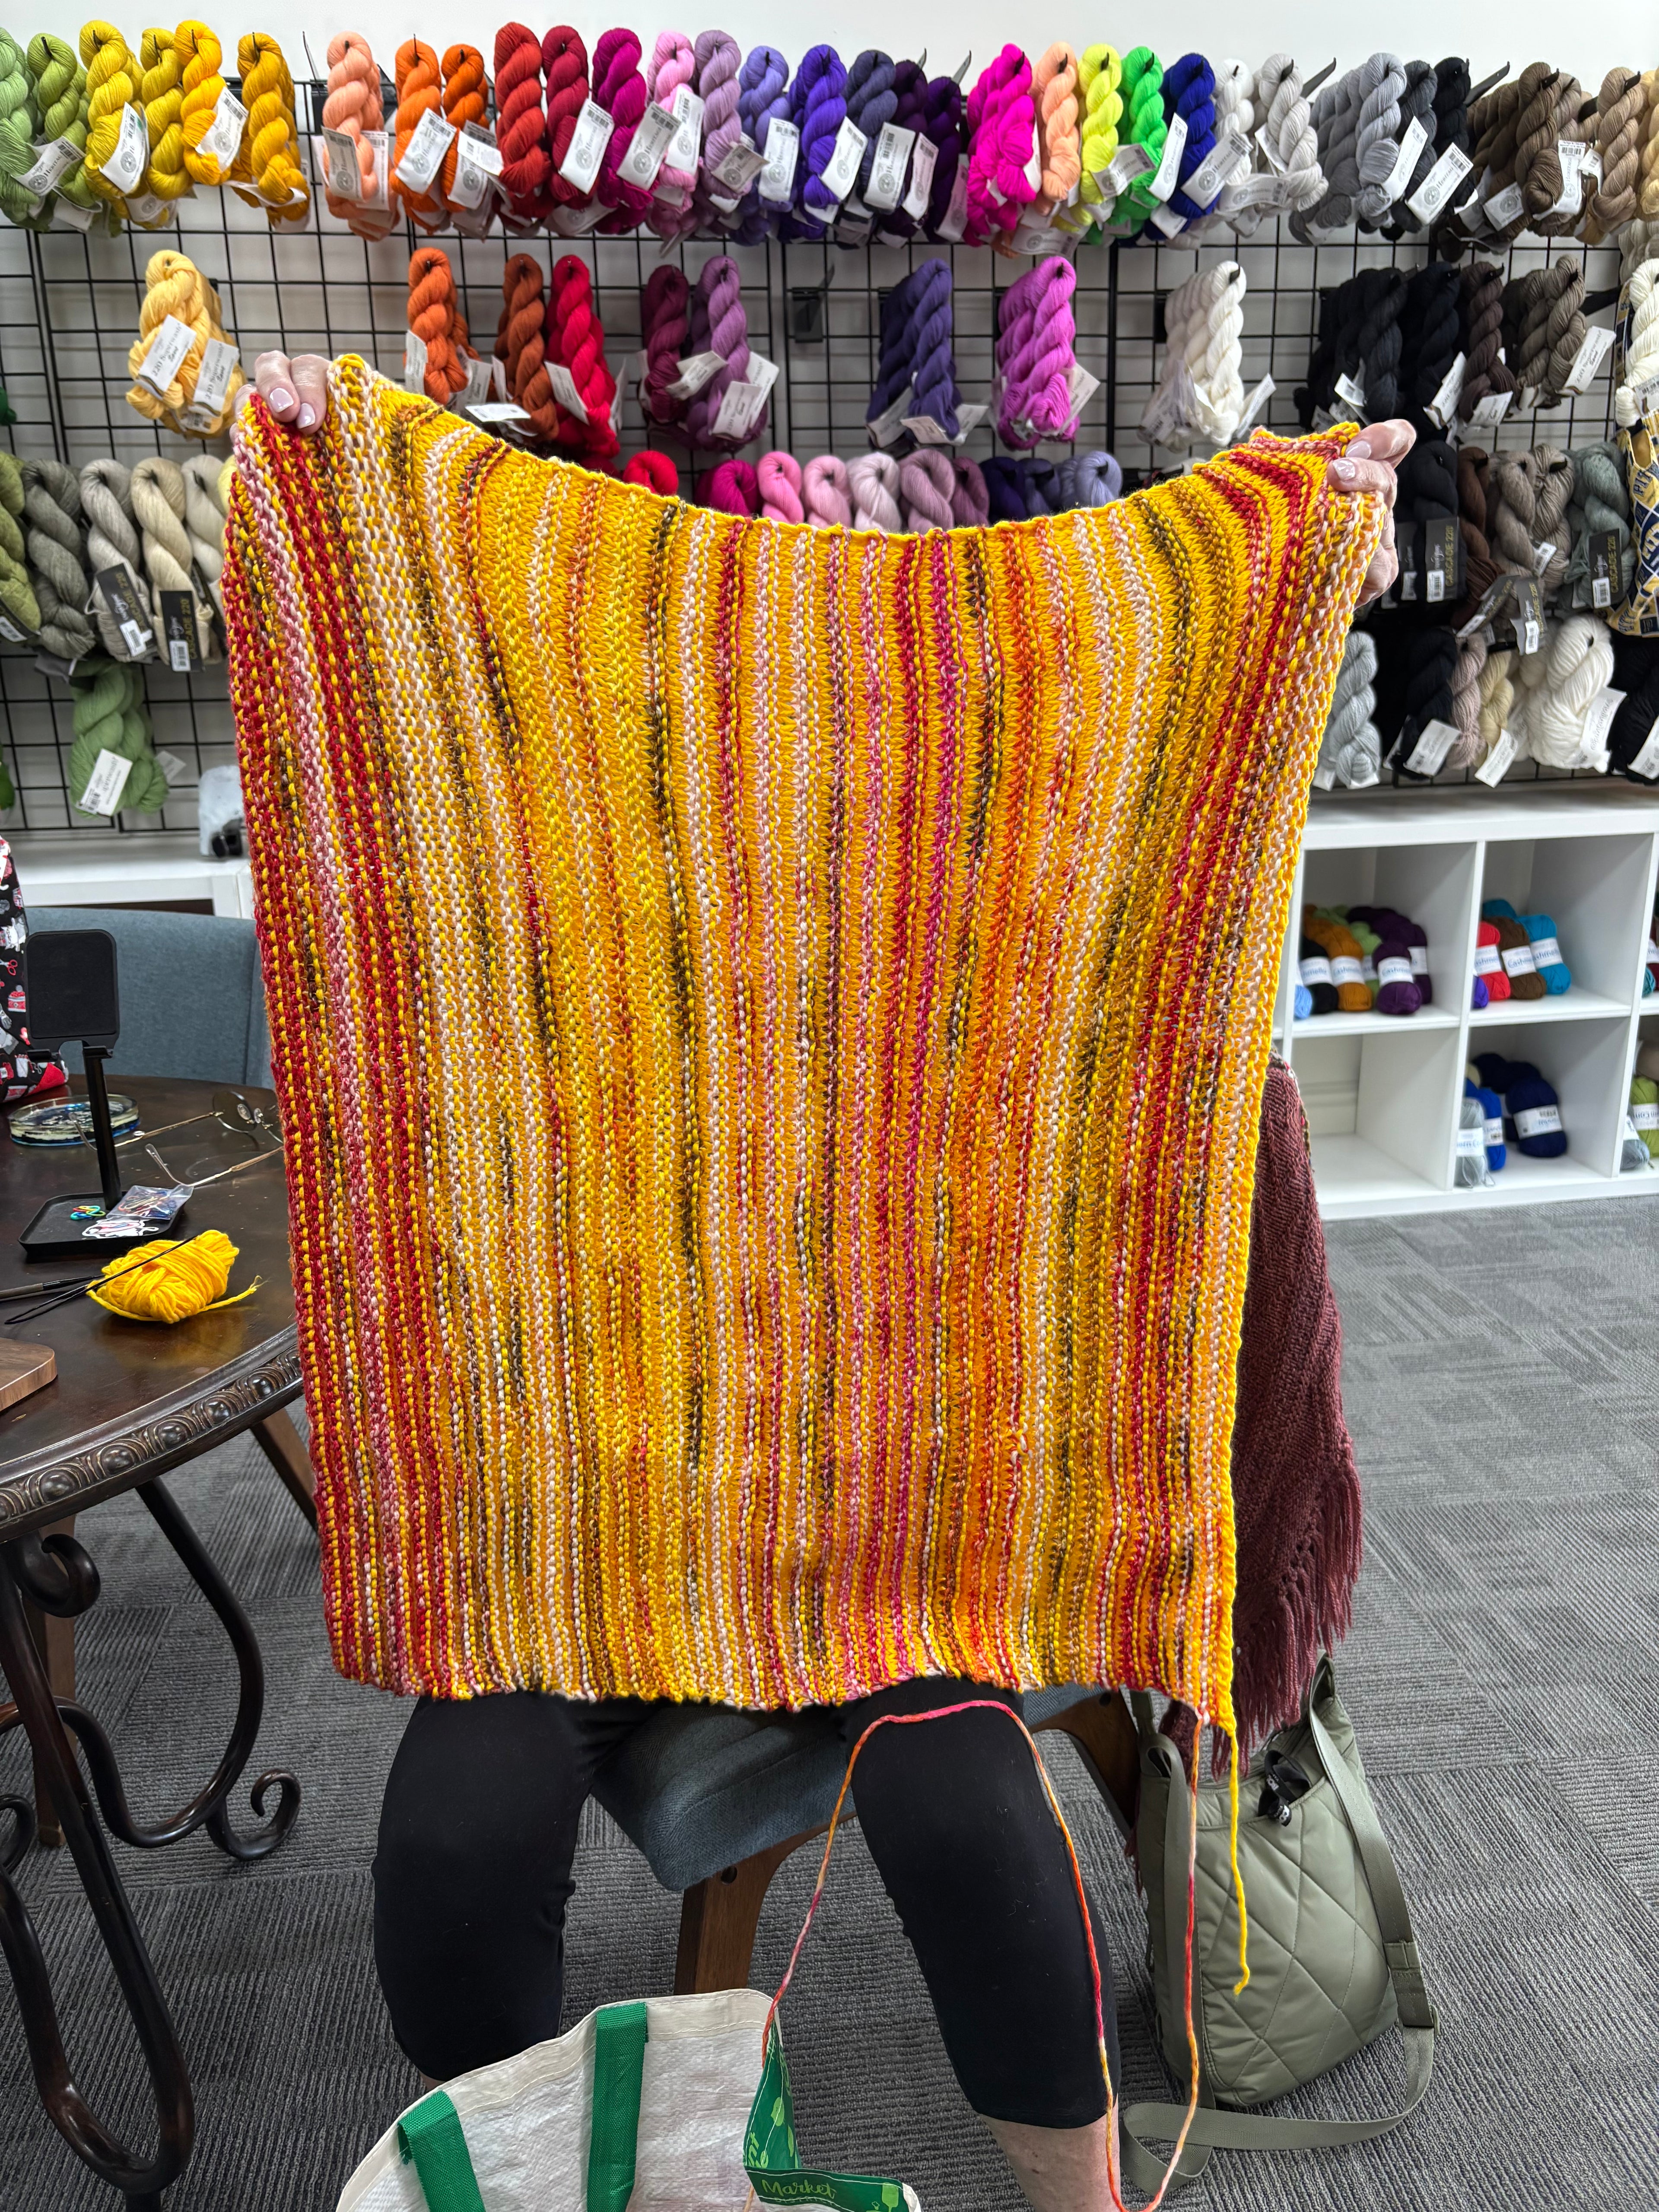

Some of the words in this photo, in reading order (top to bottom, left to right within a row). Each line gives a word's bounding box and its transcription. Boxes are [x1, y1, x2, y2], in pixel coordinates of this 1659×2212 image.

[1445, 525, 1455, 542] 220
[1607, 535, 1616, 551] 220
[115, 571, 129, 588] 220
[180, 597, 191, 615] 220
[762, 2179, 837, 2199] Market
